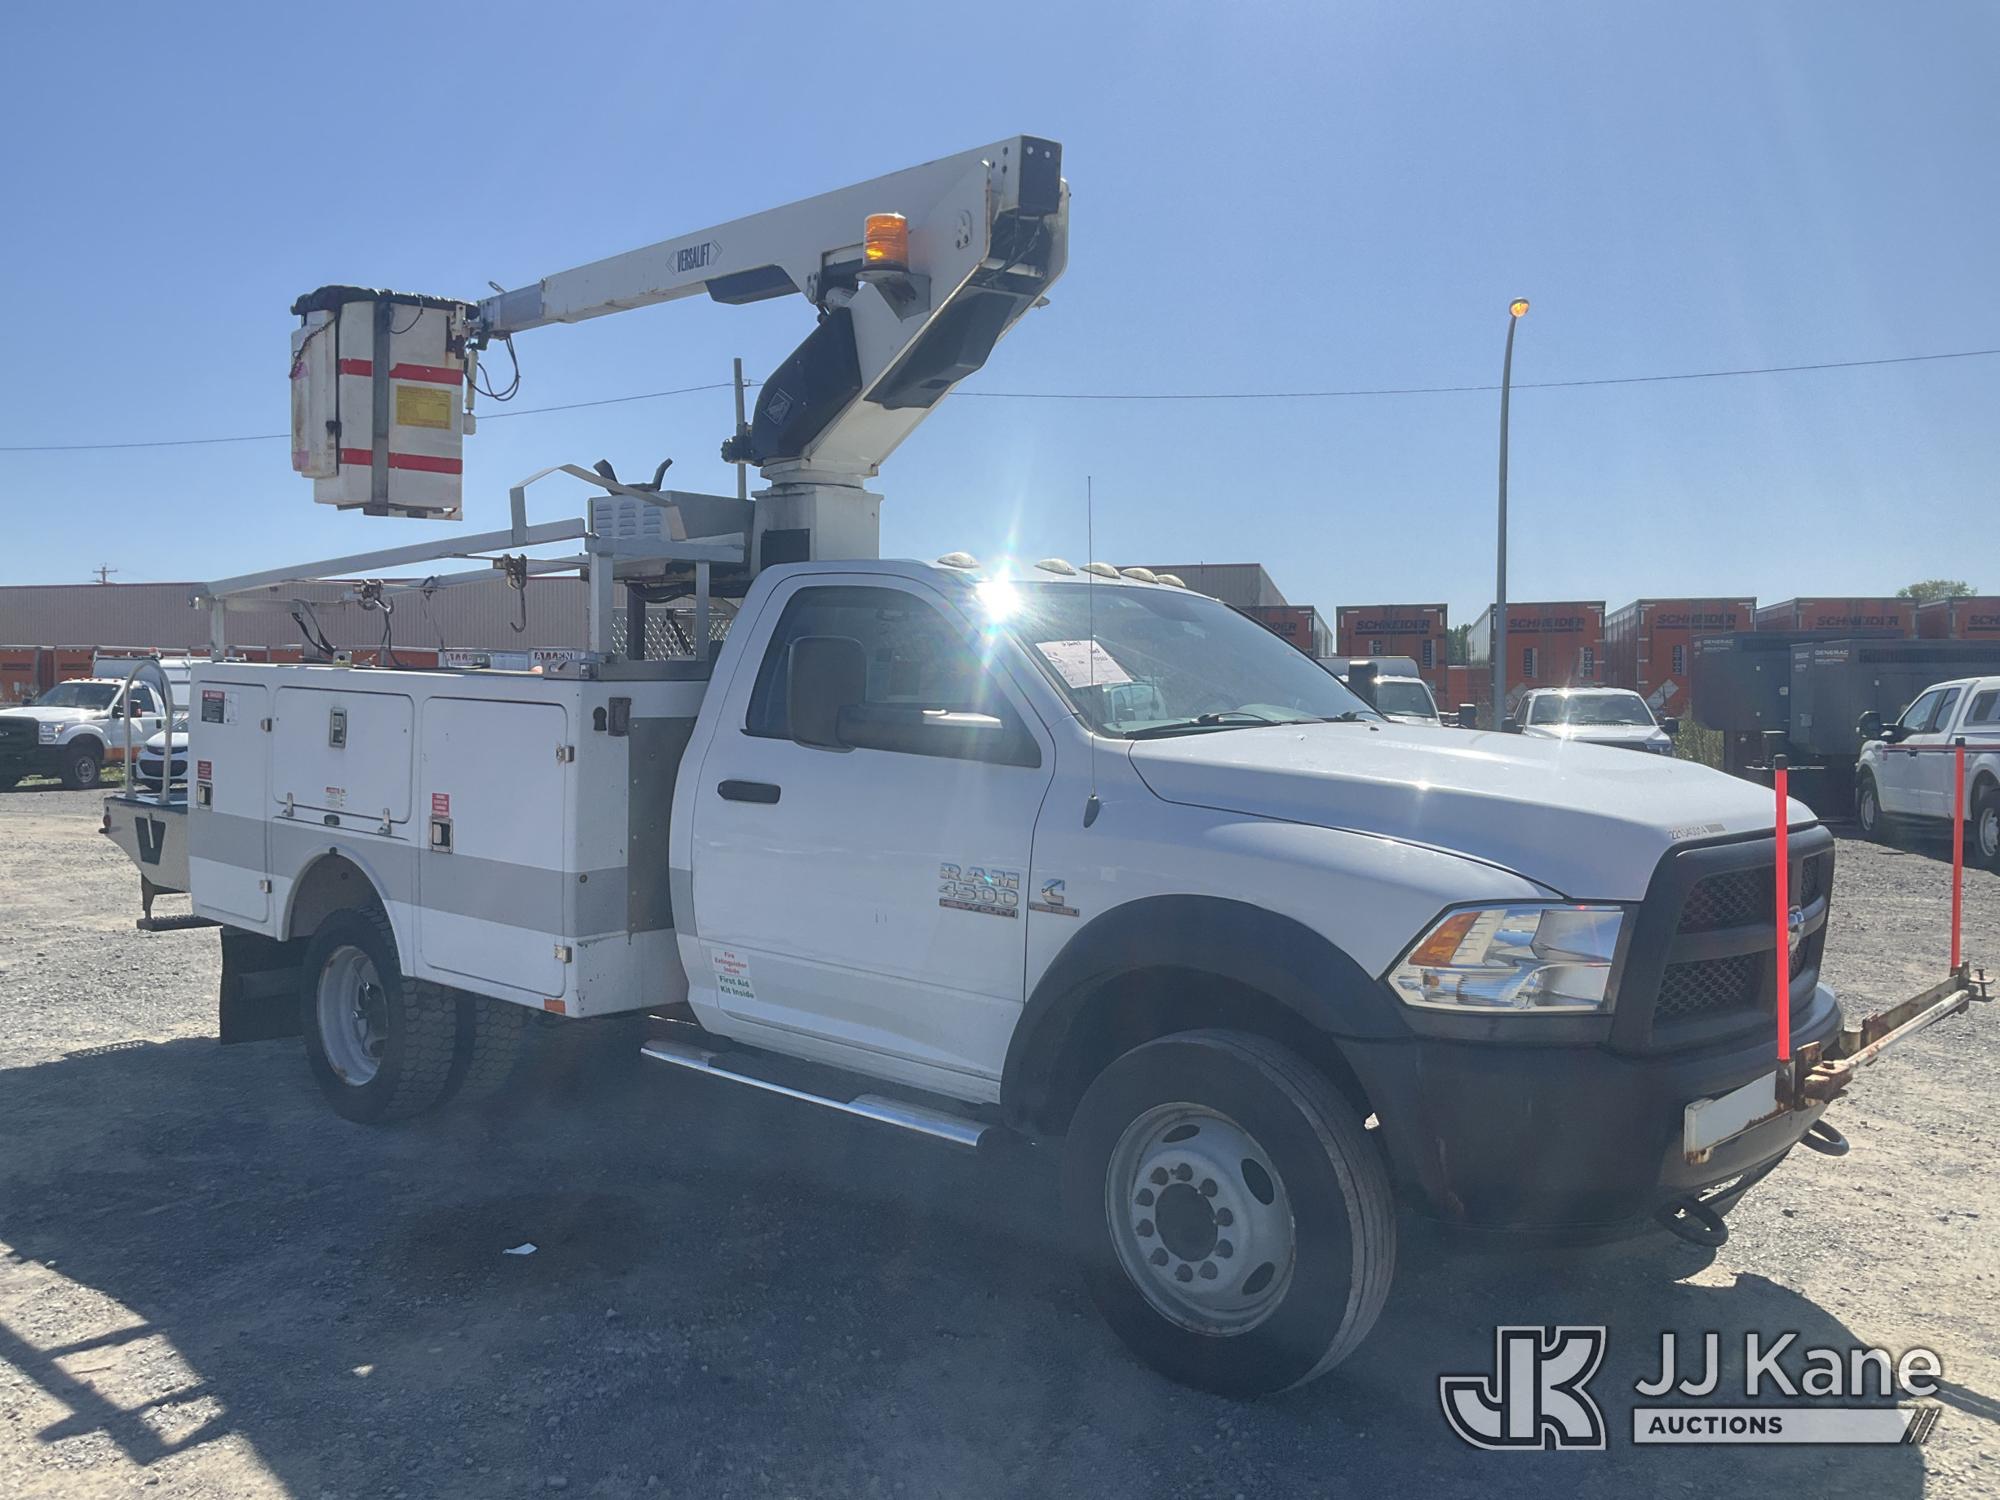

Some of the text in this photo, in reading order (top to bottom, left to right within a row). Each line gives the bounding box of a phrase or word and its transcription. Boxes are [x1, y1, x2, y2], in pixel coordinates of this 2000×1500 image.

[677, 242, 710, 272] VERSALIFT
[1355, 619, 1431, 631] SCHNEIDER
[1509, 617, 1585, 628] SCHNEIDER
[1657, 613, 1737, 625] SCHNEIDER
[1817, 615, 1900, 626] SCHNEIDER
[939, 862, 1020, 890] RAM
[938, 881, 1019, 907] 4500
[719, 975, 750, 988] First Aid
[732, 988, 754, 998] Inside
